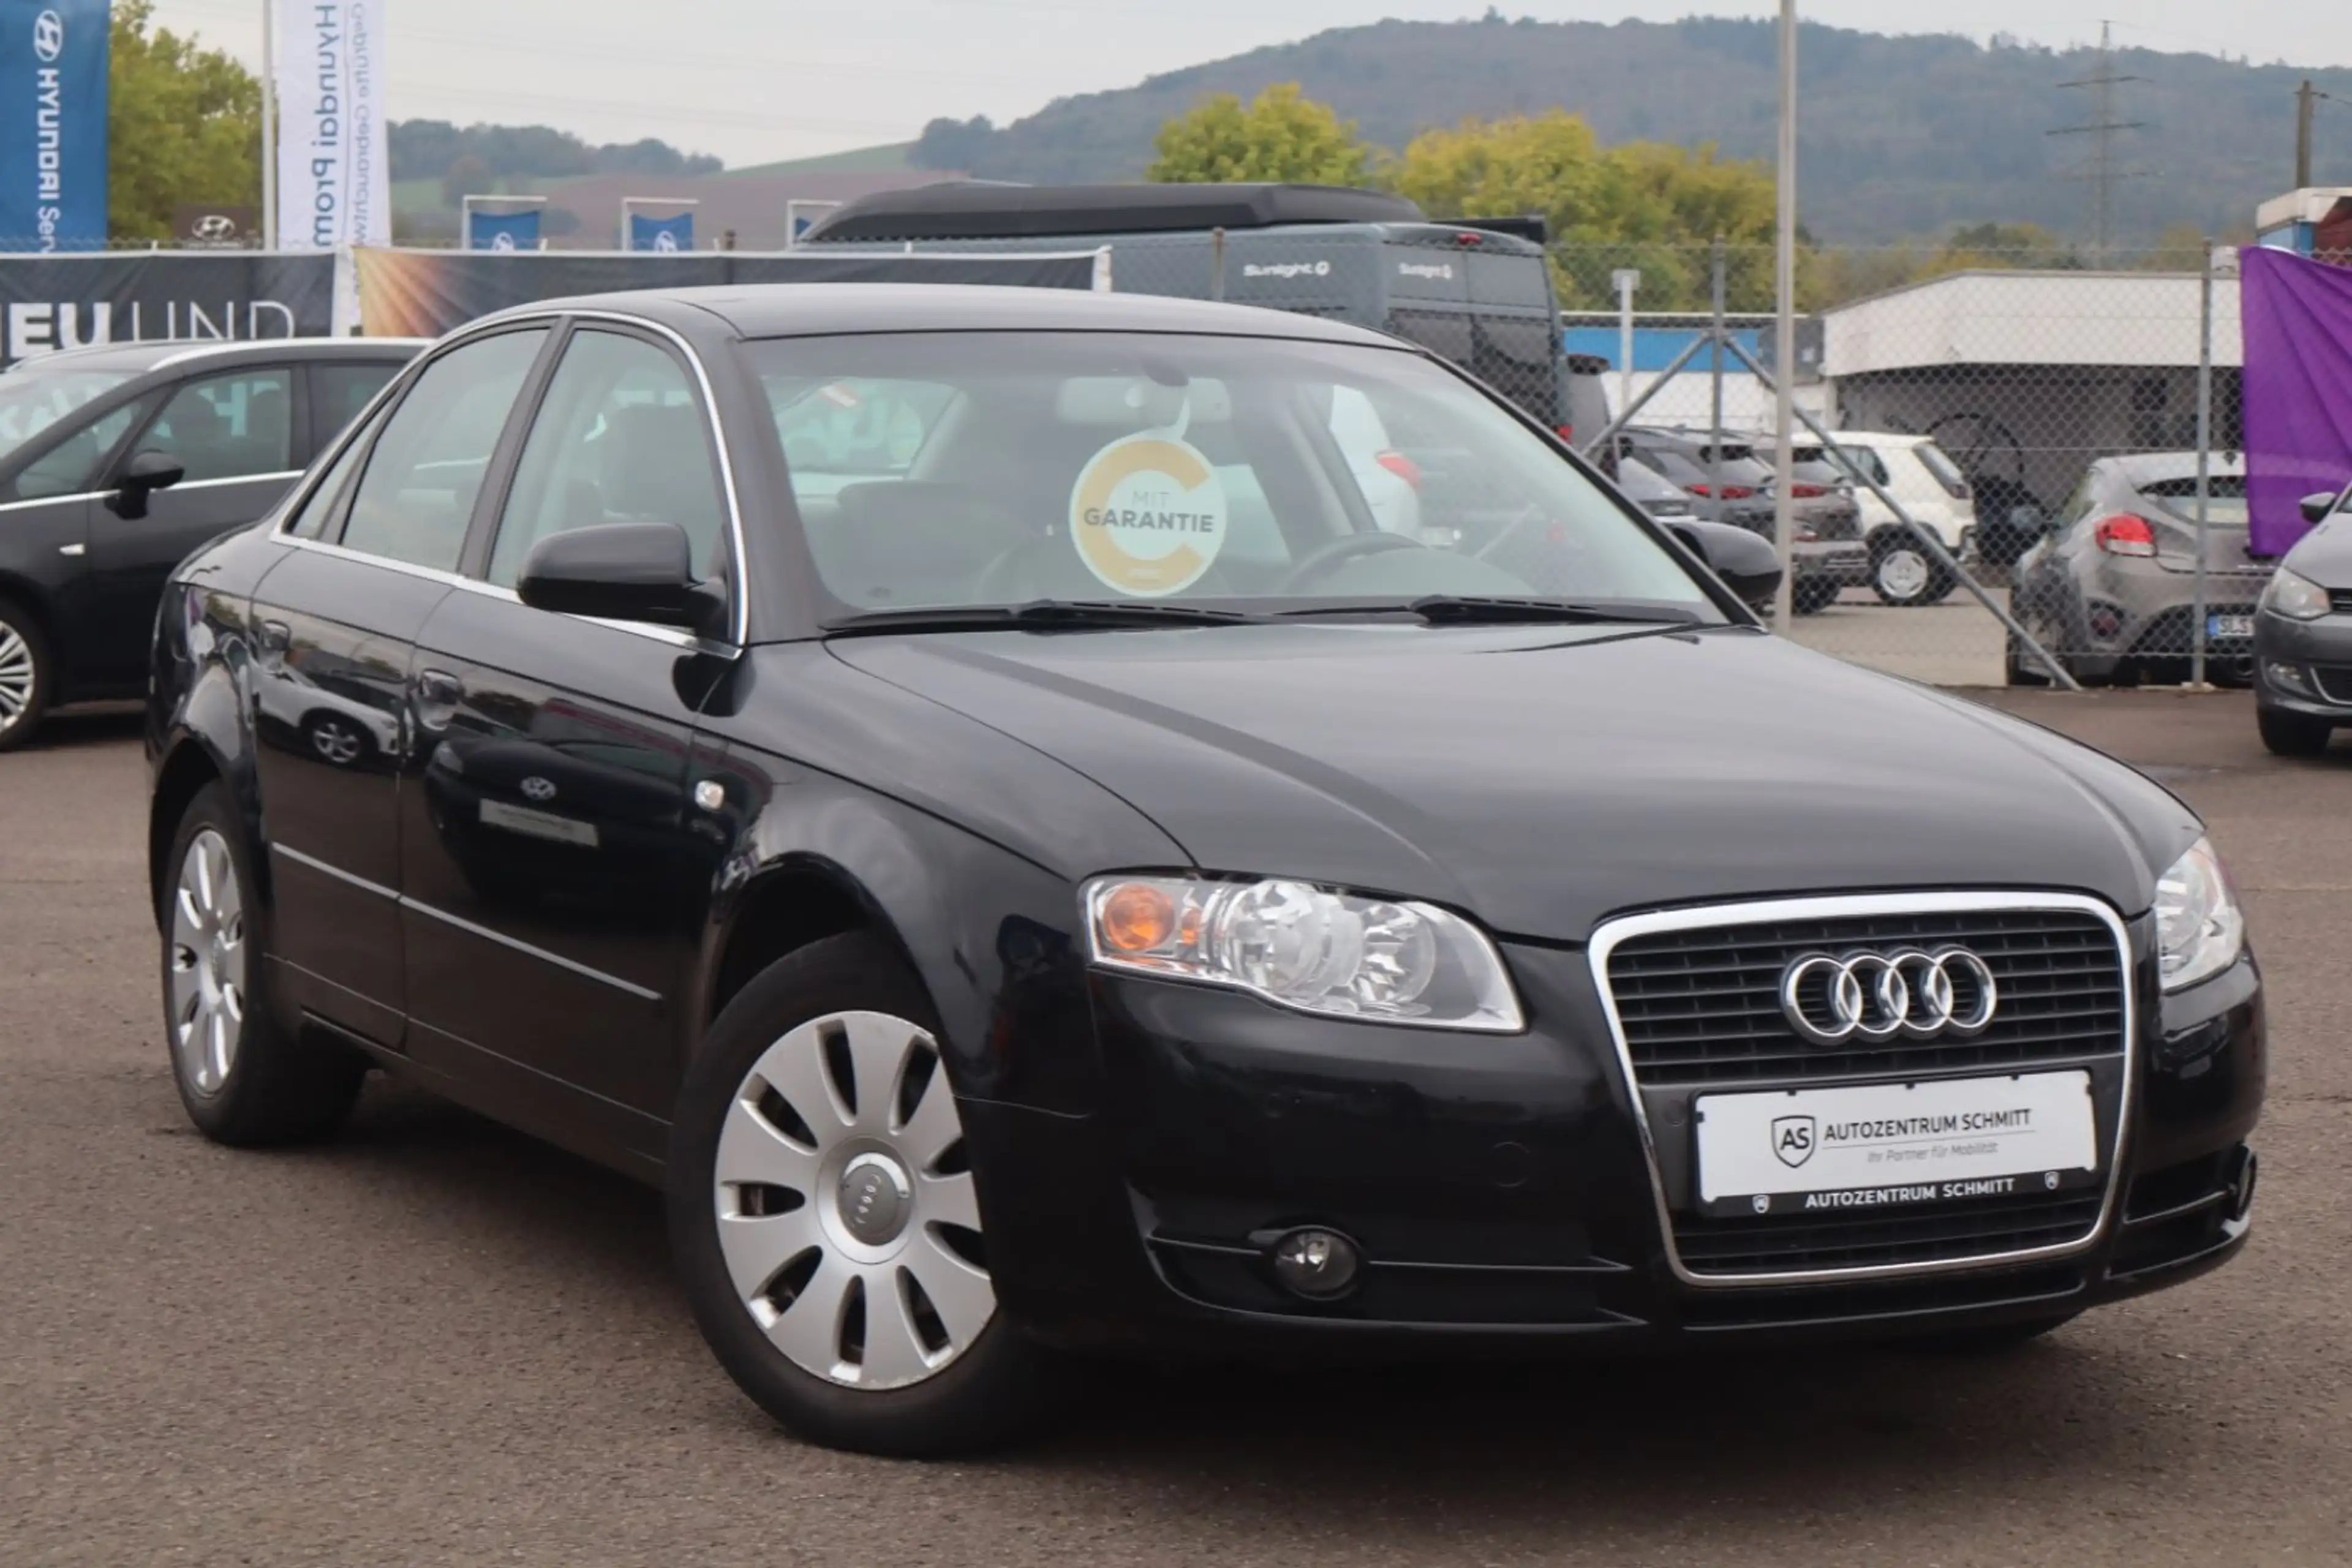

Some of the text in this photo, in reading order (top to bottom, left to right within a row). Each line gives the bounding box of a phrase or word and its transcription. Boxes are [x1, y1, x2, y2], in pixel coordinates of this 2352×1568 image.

[37, 68, 60, 200] HYUNDAI
[0, 302, 111, 358] EU
[1132, 491, 1170, 508] MIT
[1083, 507, 1215, 533] GARANTIE
[1779, 1127, 1811, 1150] AS
[1824, 1108, 2032, 1141] AUTOZENTRUM SCHMITT
[1804, 1177, 2015, 1208] AUTOZENTRUM SCHMITT
